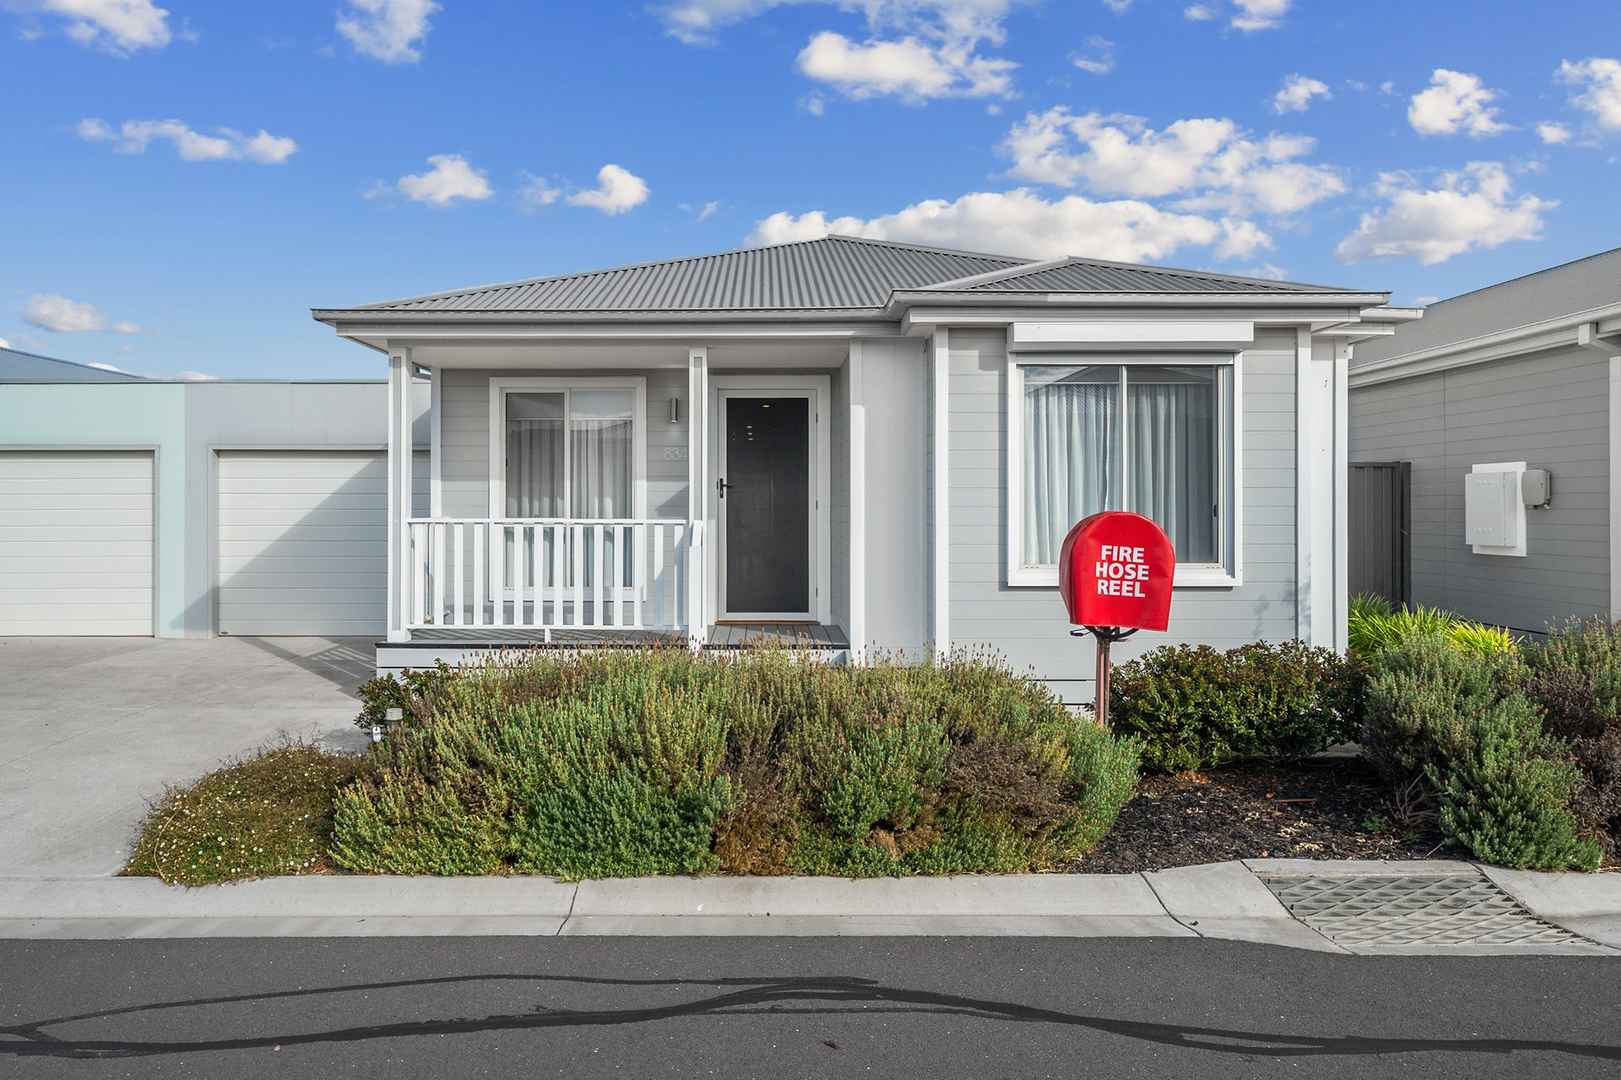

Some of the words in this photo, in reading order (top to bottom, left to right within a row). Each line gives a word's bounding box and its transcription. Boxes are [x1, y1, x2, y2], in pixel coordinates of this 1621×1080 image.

[1101, 545, 1145, 563] FIRE
[1095, 561, 1150, 581] HOSE
[1097, 579, 1146, 598] REEL
